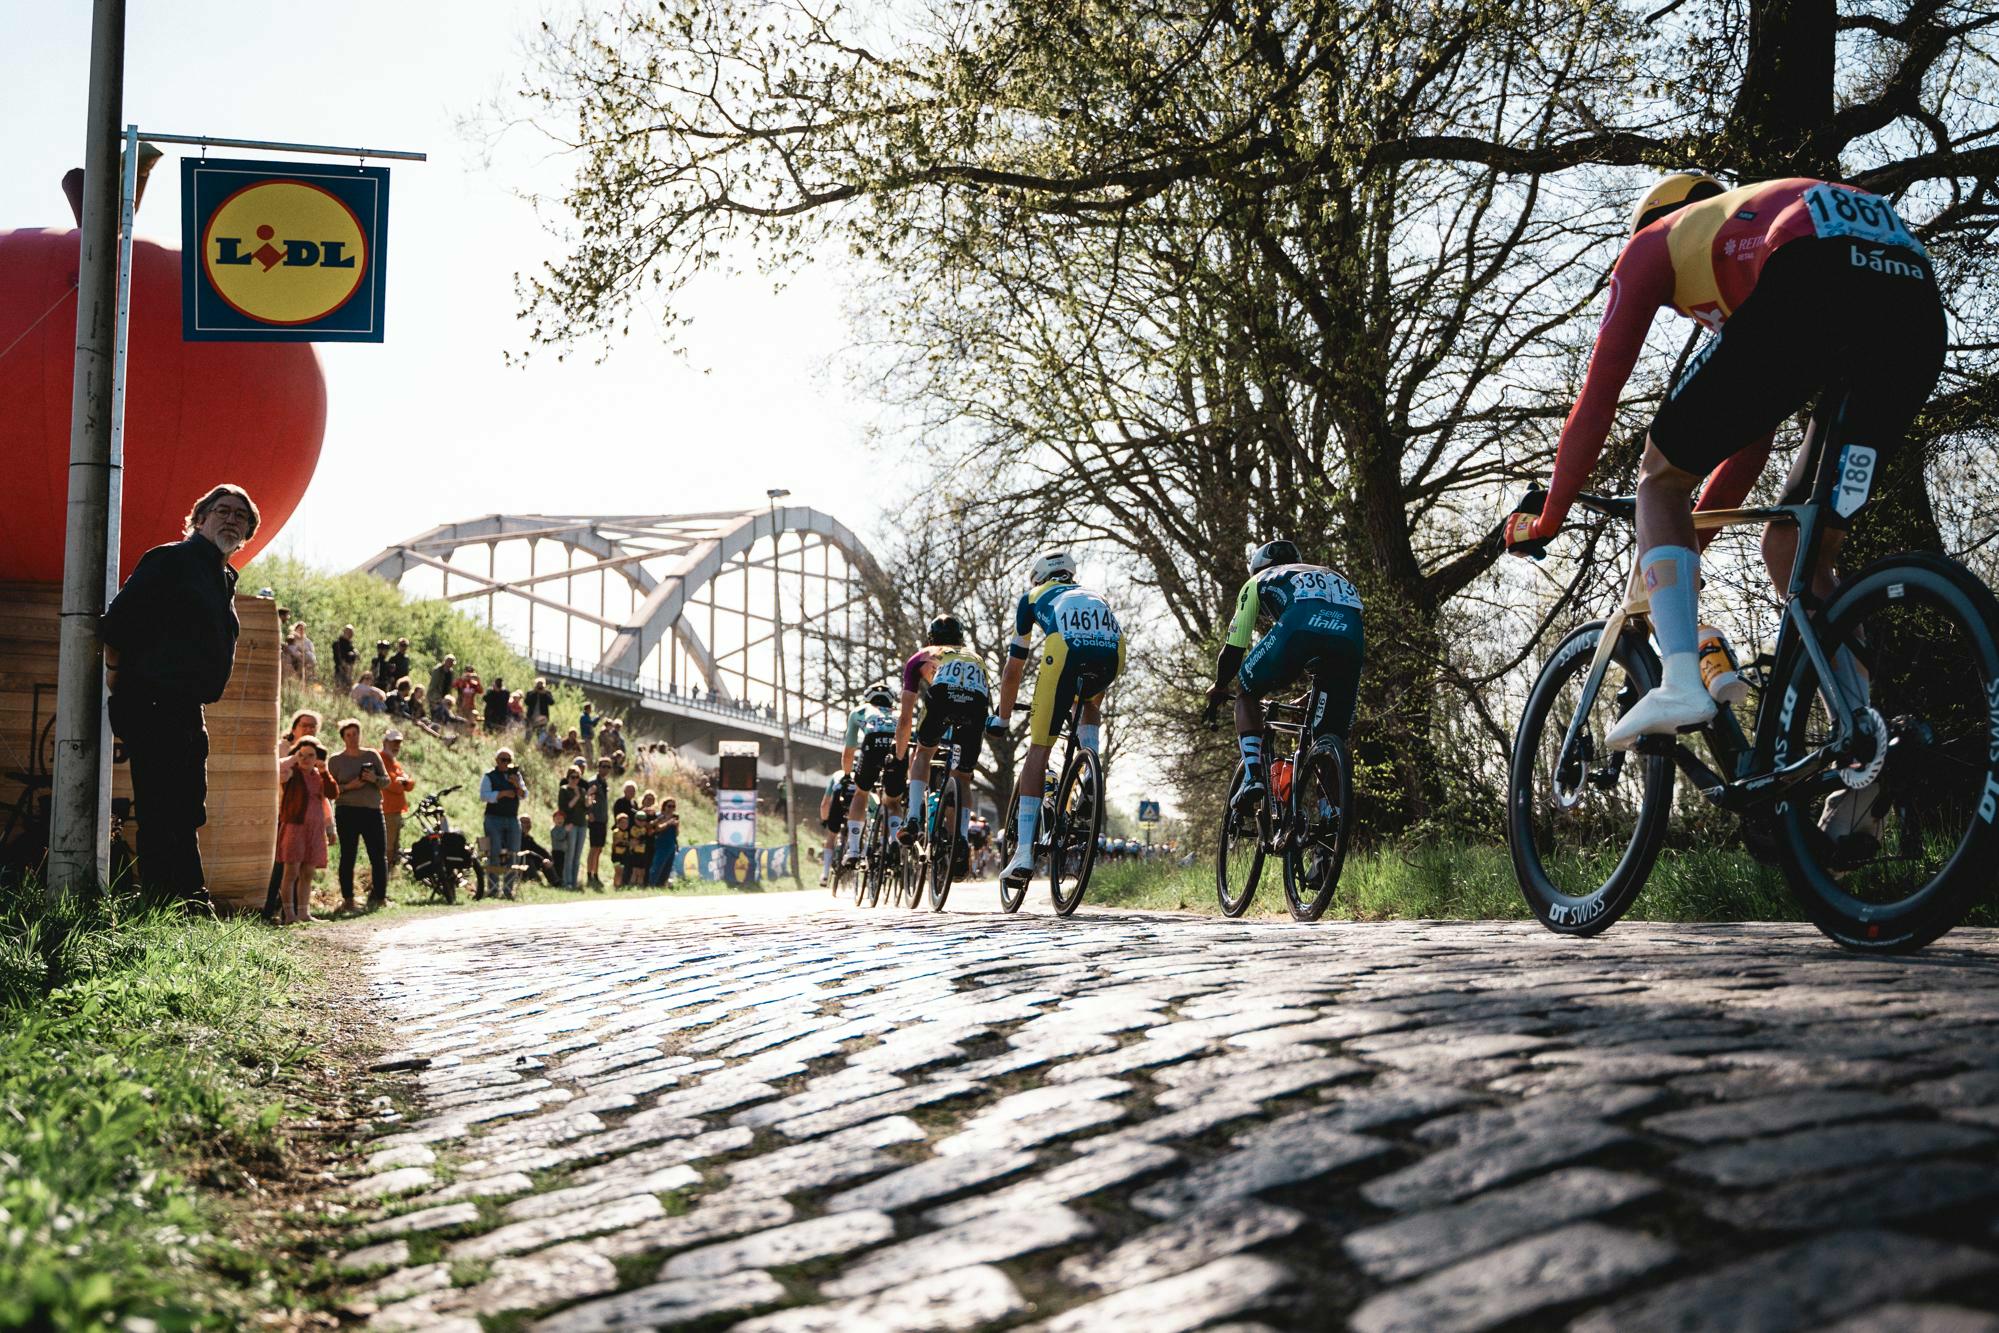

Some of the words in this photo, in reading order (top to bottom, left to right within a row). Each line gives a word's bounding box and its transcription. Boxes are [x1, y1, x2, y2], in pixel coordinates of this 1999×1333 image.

[1842, 453, 1872, 496] 186
[1061, 610, 1091, 631] 146
[1308, 614, 1348, 632] italia
[1318, 608, 1345, 620] selle
[1082, 638, 1117, 649] baloise
[1263, 634, 1277, 650] Tech
[1559, 630, 1593, 668] SWISS
[1780, 683, 1798, 733] DT
[719, 811, 756, 821] KBC
[1548, 902, 1569, 924] DT
[1569, 891, 1605, 925] SWISS
